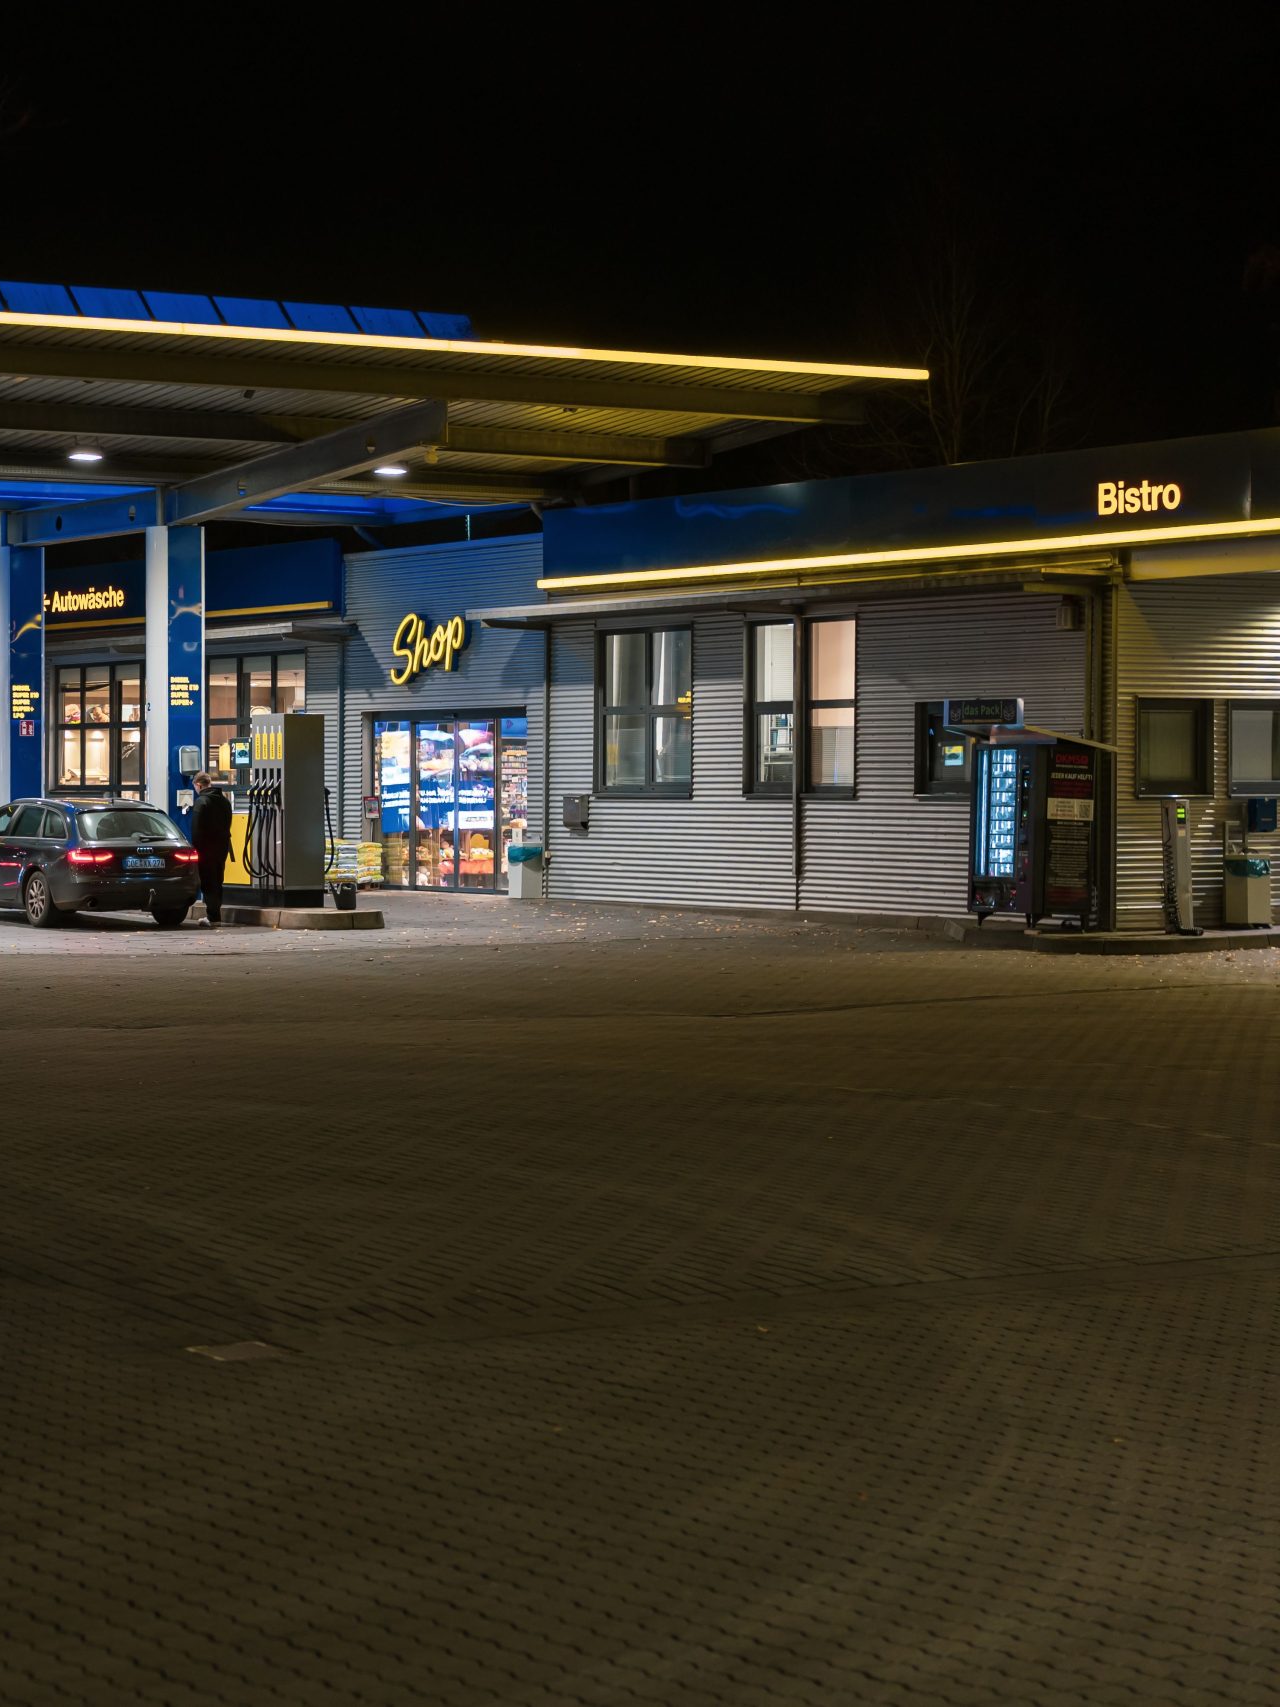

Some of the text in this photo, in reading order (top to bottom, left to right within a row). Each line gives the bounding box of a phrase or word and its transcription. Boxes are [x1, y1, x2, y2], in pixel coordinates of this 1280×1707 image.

[1098, 480, 1181, 515] Bistro
[52, 585, 124, 612] Autowäsche
[390, 612, 464, 685] Shop
[170, 698, 194, 706] SUPER+
[231, 742, 236, 753] 2
